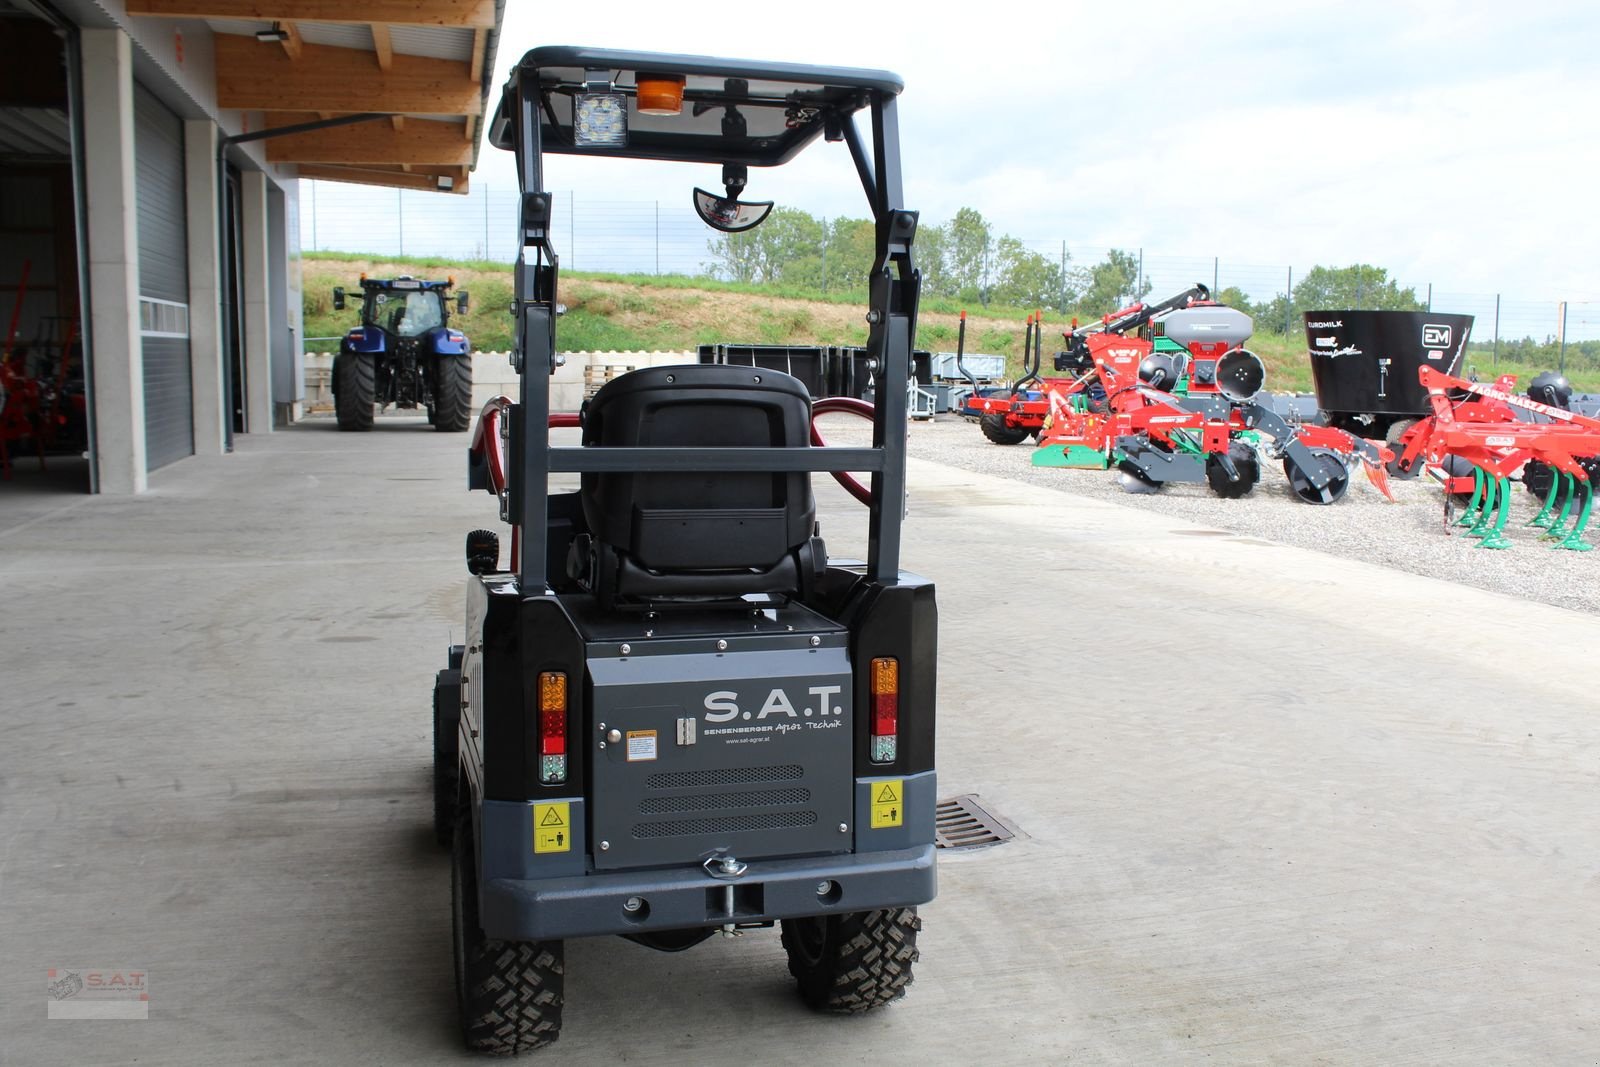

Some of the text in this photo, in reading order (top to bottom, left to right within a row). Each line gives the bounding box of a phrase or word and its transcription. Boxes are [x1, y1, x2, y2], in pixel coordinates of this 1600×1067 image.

[1308, 320, 1343, 328] EUROMILK
[703, 685, 842, 723] S.A.T.
[704, 719, 842, 736] SENSENBERGER Agrar Technik
[725, 736, 770, 744] www.sat-agrar.at
